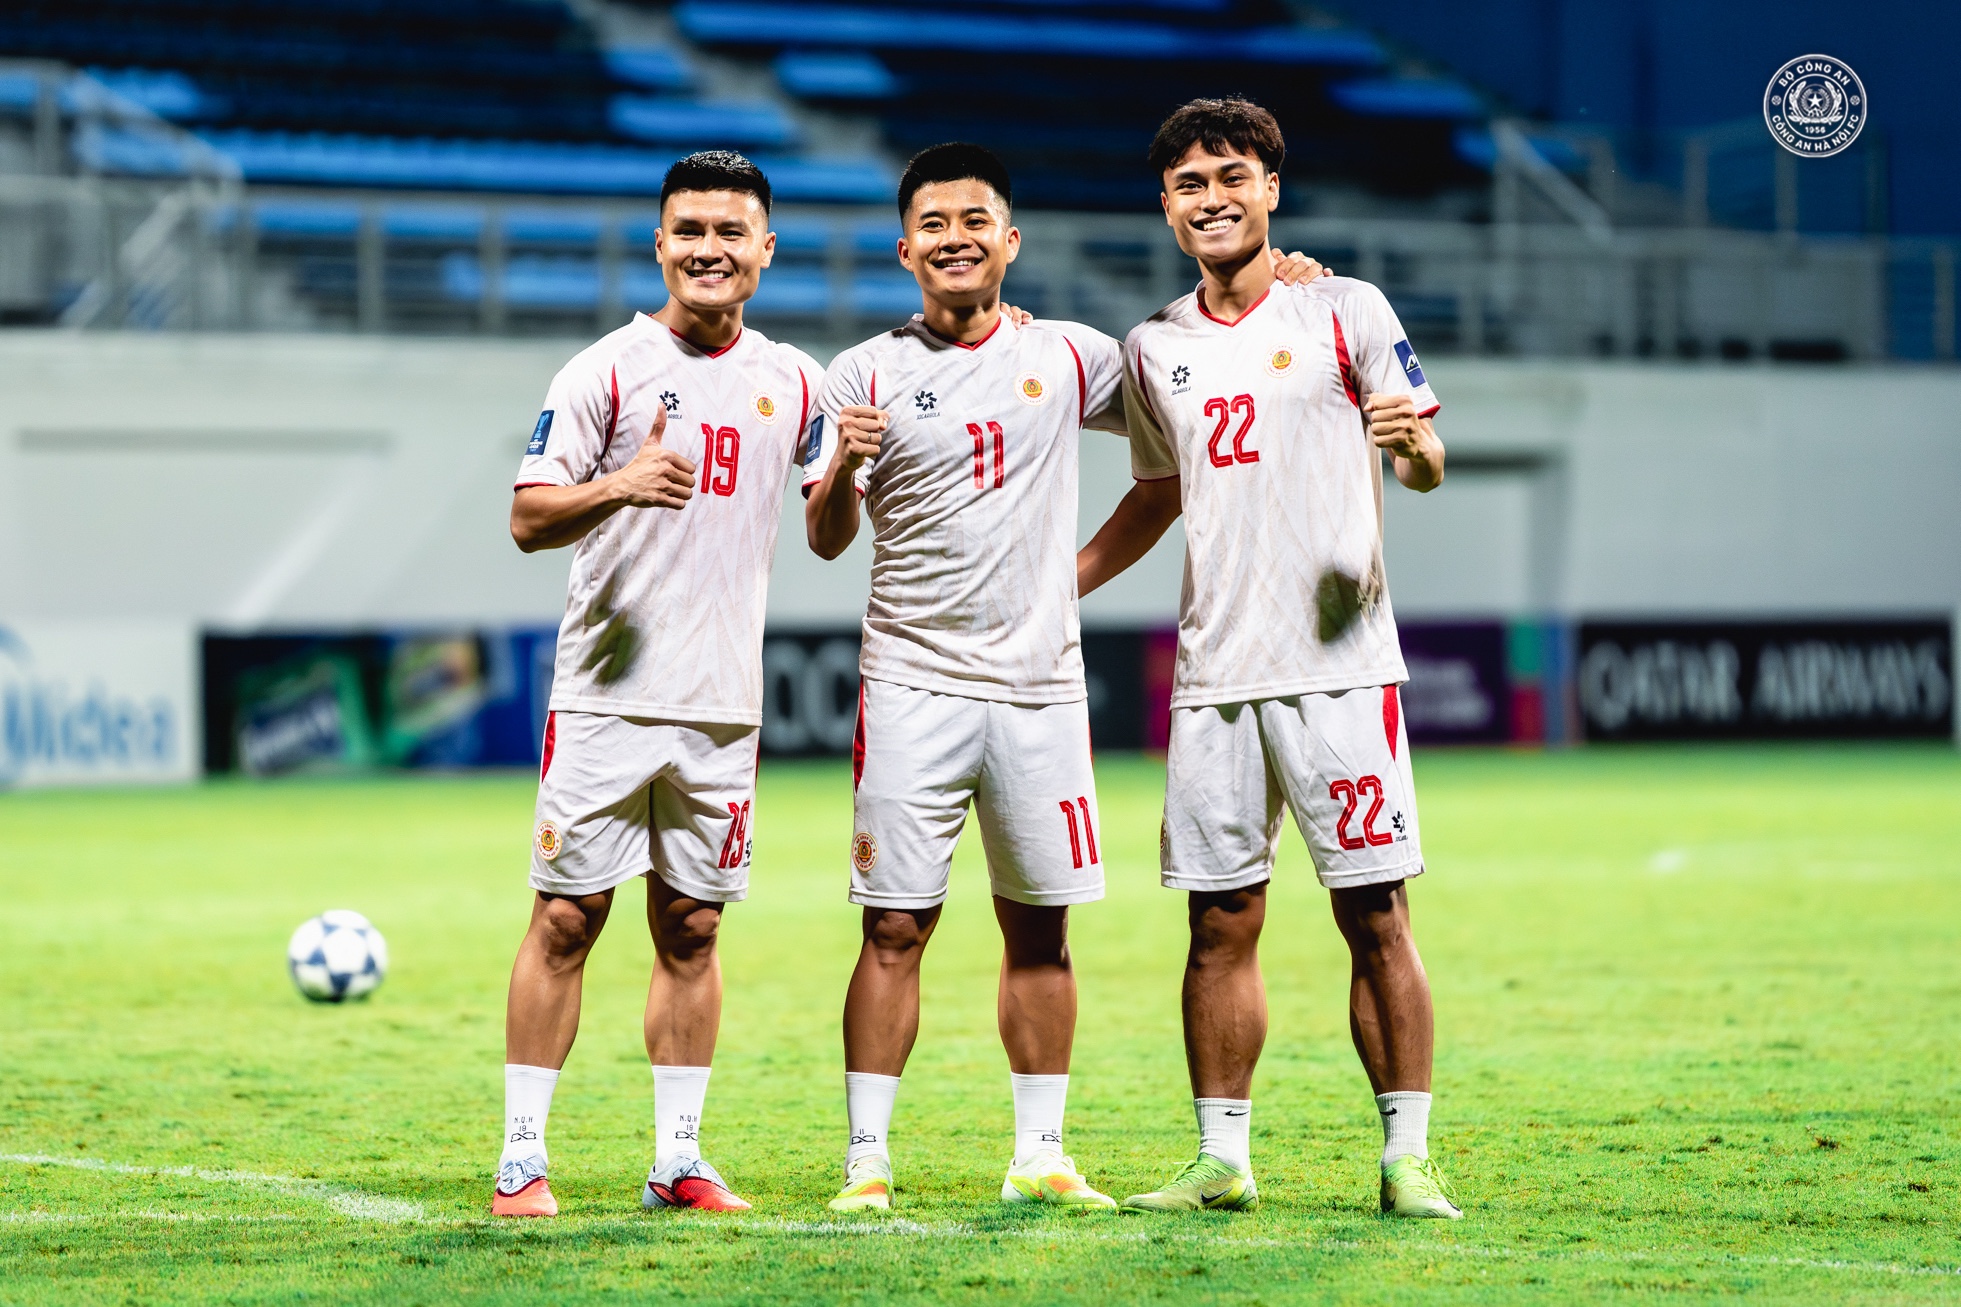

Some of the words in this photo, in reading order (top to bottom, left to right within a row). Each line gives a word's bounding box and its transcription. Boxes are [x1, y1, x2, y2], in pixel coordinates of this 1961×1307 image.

[700, 422, 741, 497] 19
[965, 420, 1005, 489] 11
[1204, 393, 1260, 468] 22
[717, 799, 751, 869] 19
[1059, 795, 1099, 870] 11
[1329, 774, 1394, 851] 22
